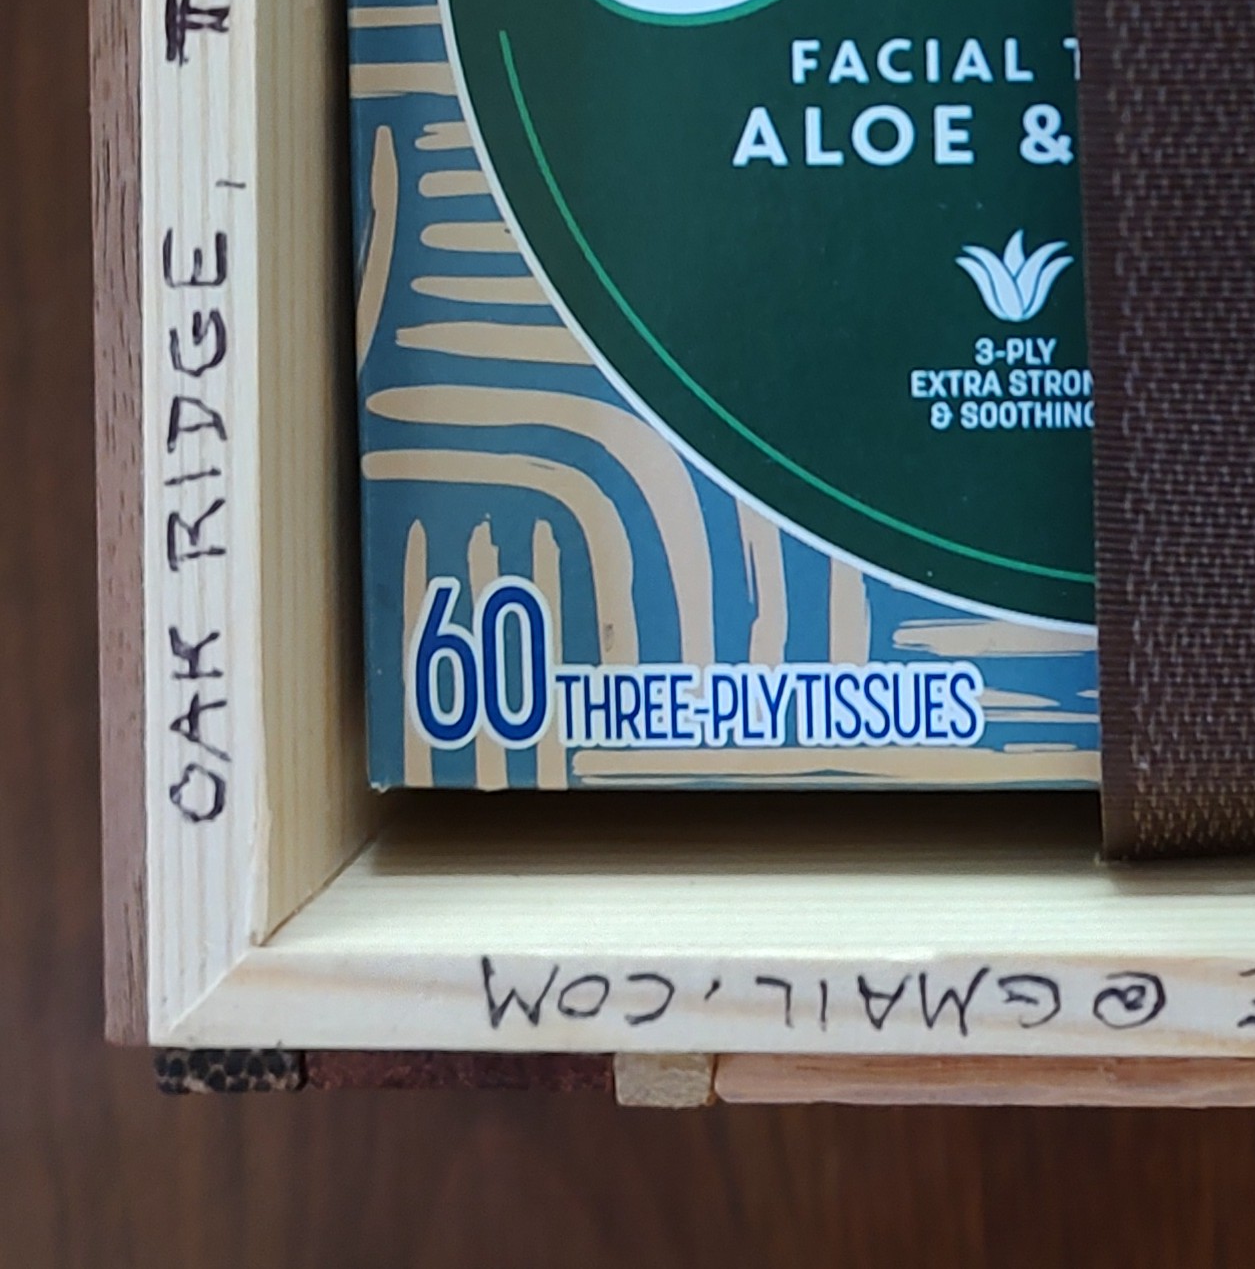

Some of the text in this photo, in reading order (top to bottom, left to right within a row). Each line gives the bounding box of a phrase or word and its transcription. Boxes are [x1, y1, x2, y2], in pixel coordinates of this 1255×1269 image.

[790, 37, 1034, 85] FACIAL
[732, 105, 974, 167] ALOE
[1019, 103, 1074, 165] &
[974, 337, 1058, 366] 3-PLY
[910, 368, 1096, 398] EXTRA STRON
[930, 401, 953, 430] &
[414, 586, 979, 742] 60 THREE-PLY TISSUES
[168, 626, 232, 825] OAK
